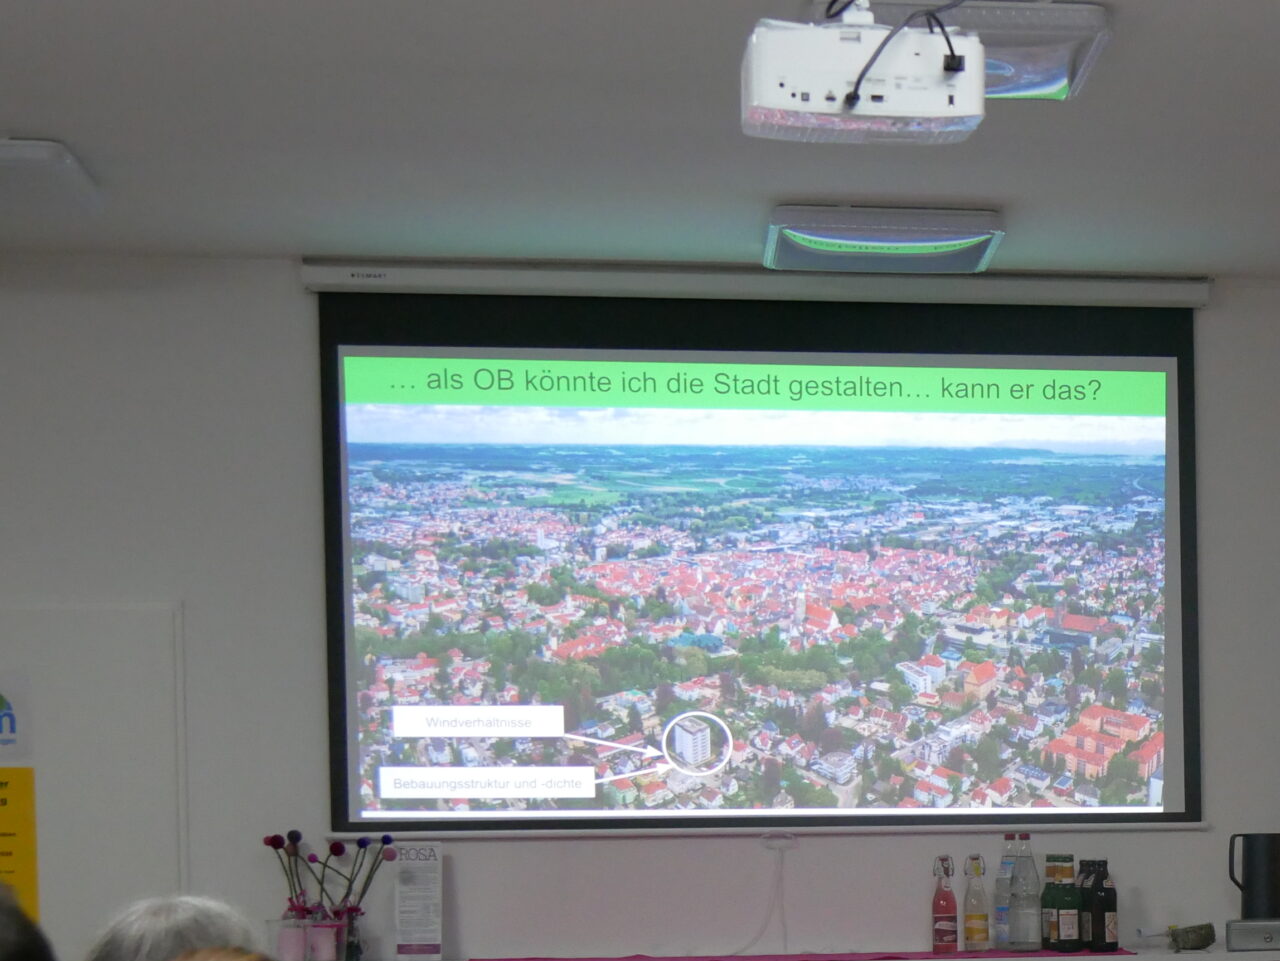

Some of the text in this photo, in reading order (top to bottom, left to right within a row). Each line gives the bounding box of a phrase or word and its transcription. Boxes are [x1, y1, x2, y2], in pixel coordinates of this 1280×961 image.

[427, 368, 463, 391] als
[474, 368, 515, 391] OB
[525, 369, 612, 393] könnte
[621, 371, 657, 394] ich
[666, 372, 704, 395] die
[714, 373, 781, 396] Stadt
[941, 377, 1000, 399] kann
[1010, 382, 1035, 400] er
[1042, 379, 1102, 402] das?
[393, 778, 583, 791] Bebauungsstruktur und -dichte
[398, 847, 439, 862] ROSA
